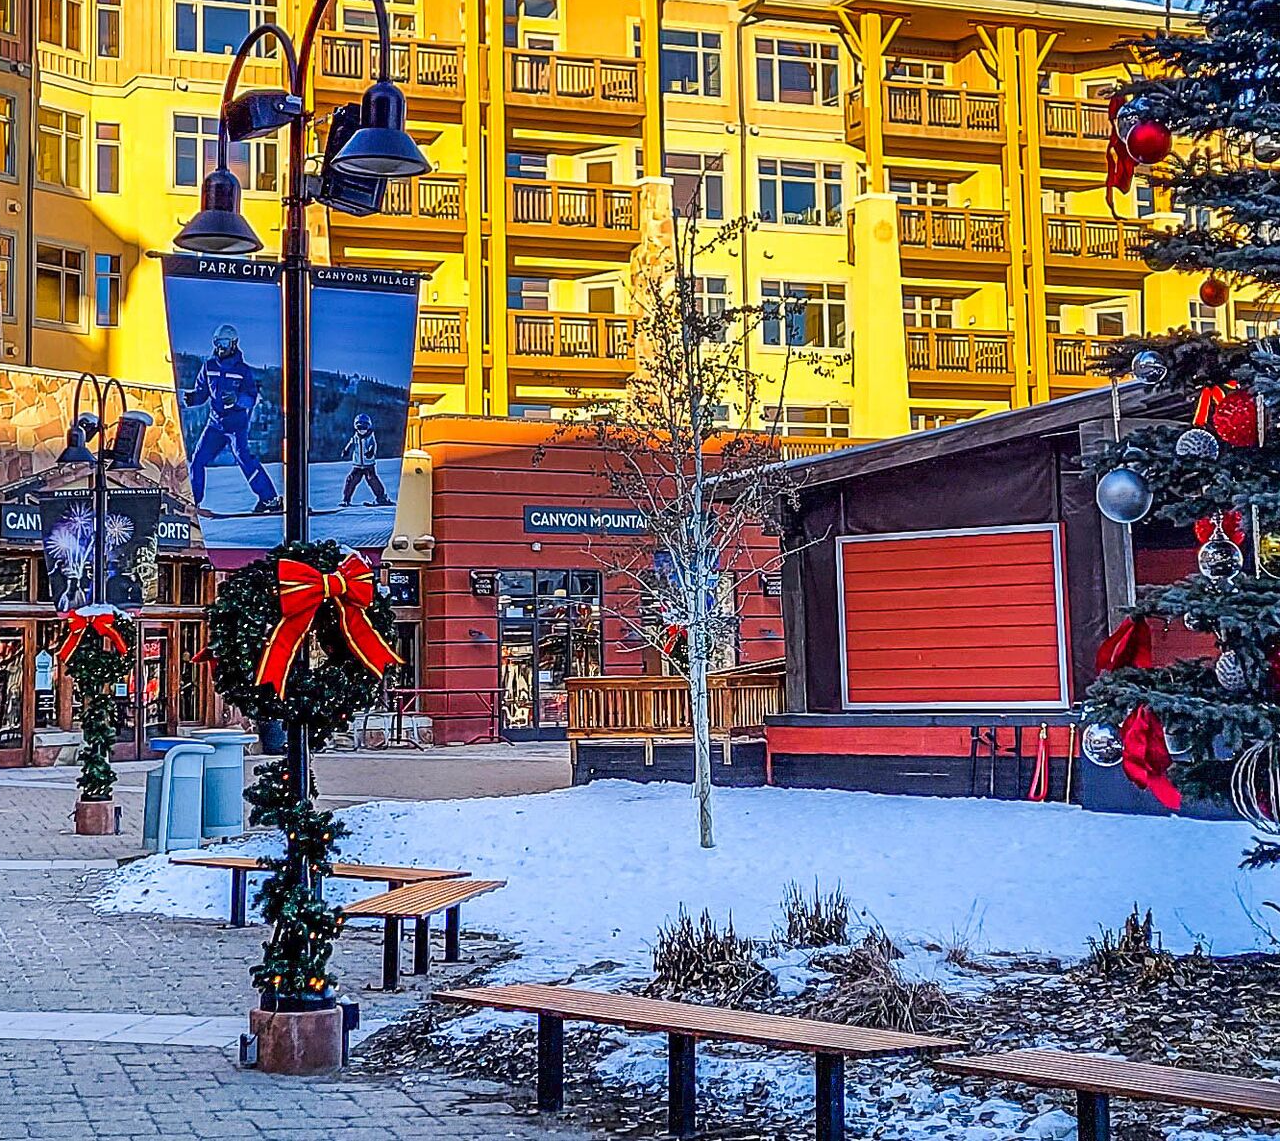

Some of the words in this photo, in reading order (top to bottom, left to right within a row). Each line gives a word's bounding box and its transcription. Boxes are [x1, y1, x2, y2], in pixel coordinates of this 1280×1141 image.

[199, 260, 237, 274] PARK
[242, 264, 276, 277] CITY
[317, 270, 368, 283] CANYONS
[372, 274, 415, 286] VILLAGE
[530, 511, 587, 528] CANYON
[589, 513, 649, 529] MOUNTAI
